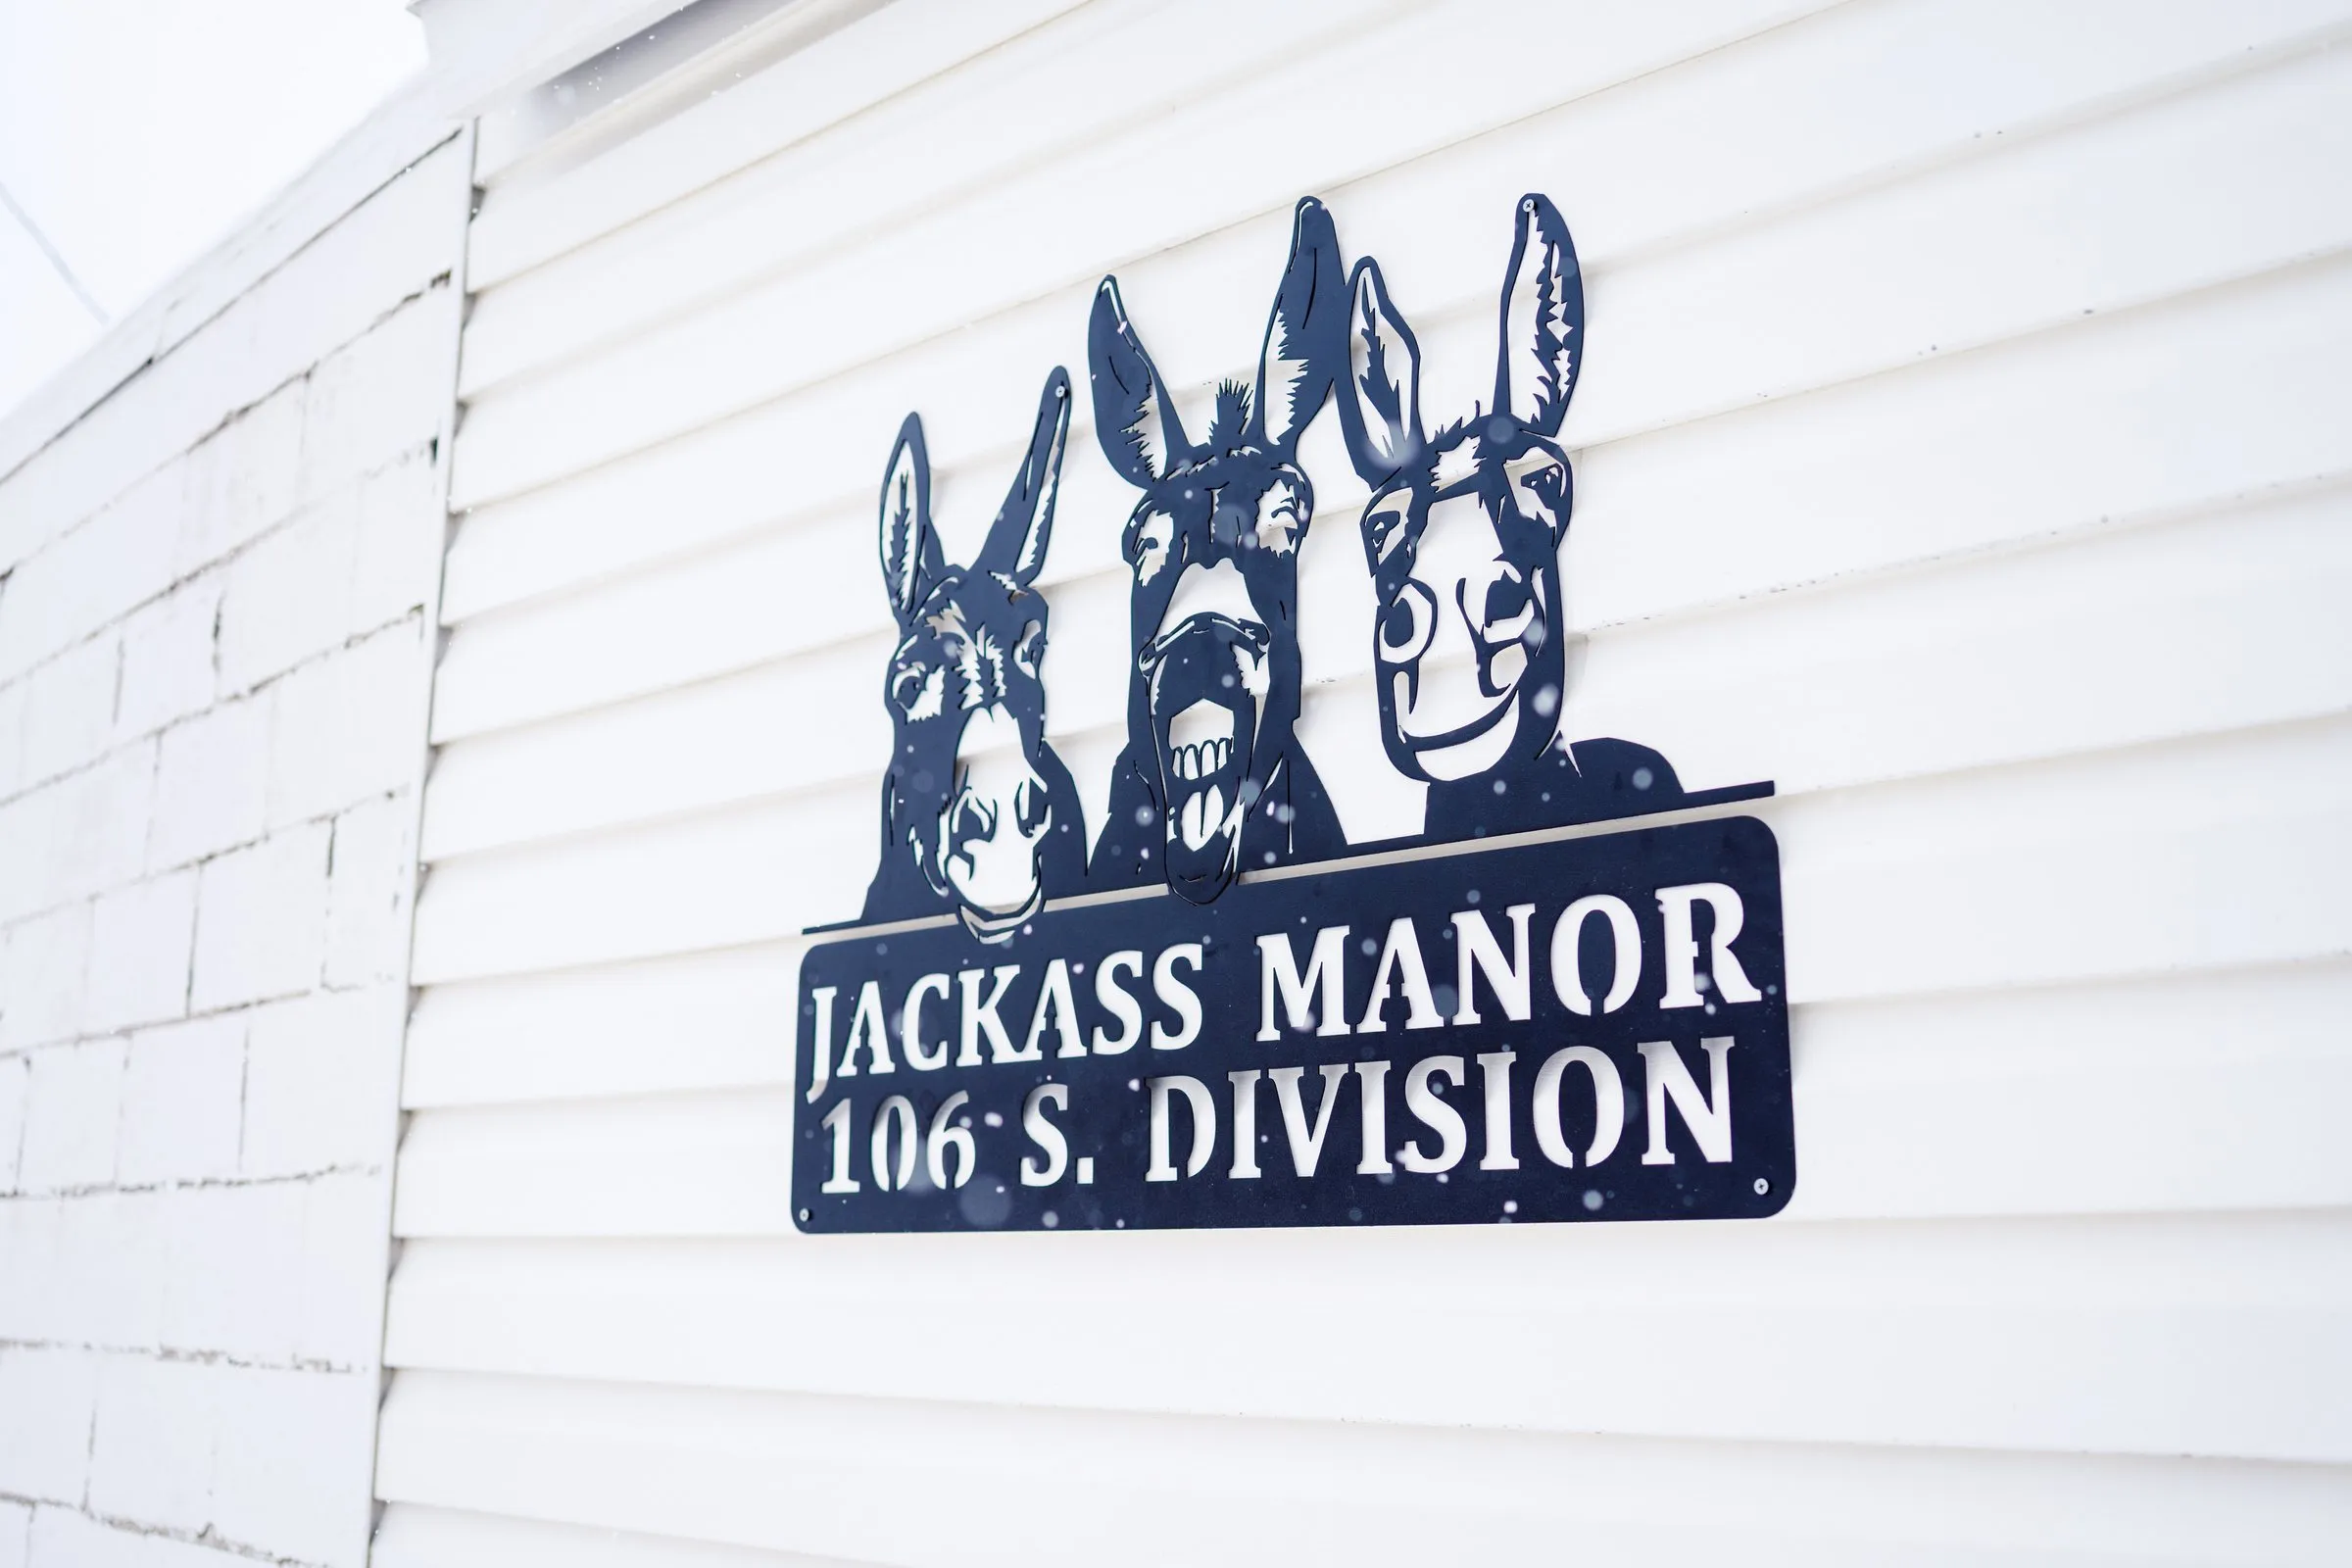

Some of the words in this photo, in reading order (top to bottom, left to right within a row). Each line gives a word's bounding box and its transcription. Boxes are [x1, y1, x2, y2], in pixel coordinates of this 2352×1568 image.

[806, 943, 1203, 1104] JACKASS
[1255, 882, 1762, 1042] MANOR
[821, 1090, 976, 1195] 106
[1020, 1083, 1095, 1188] S.
[1145, 1036, 1736, 1183] DIVISION
